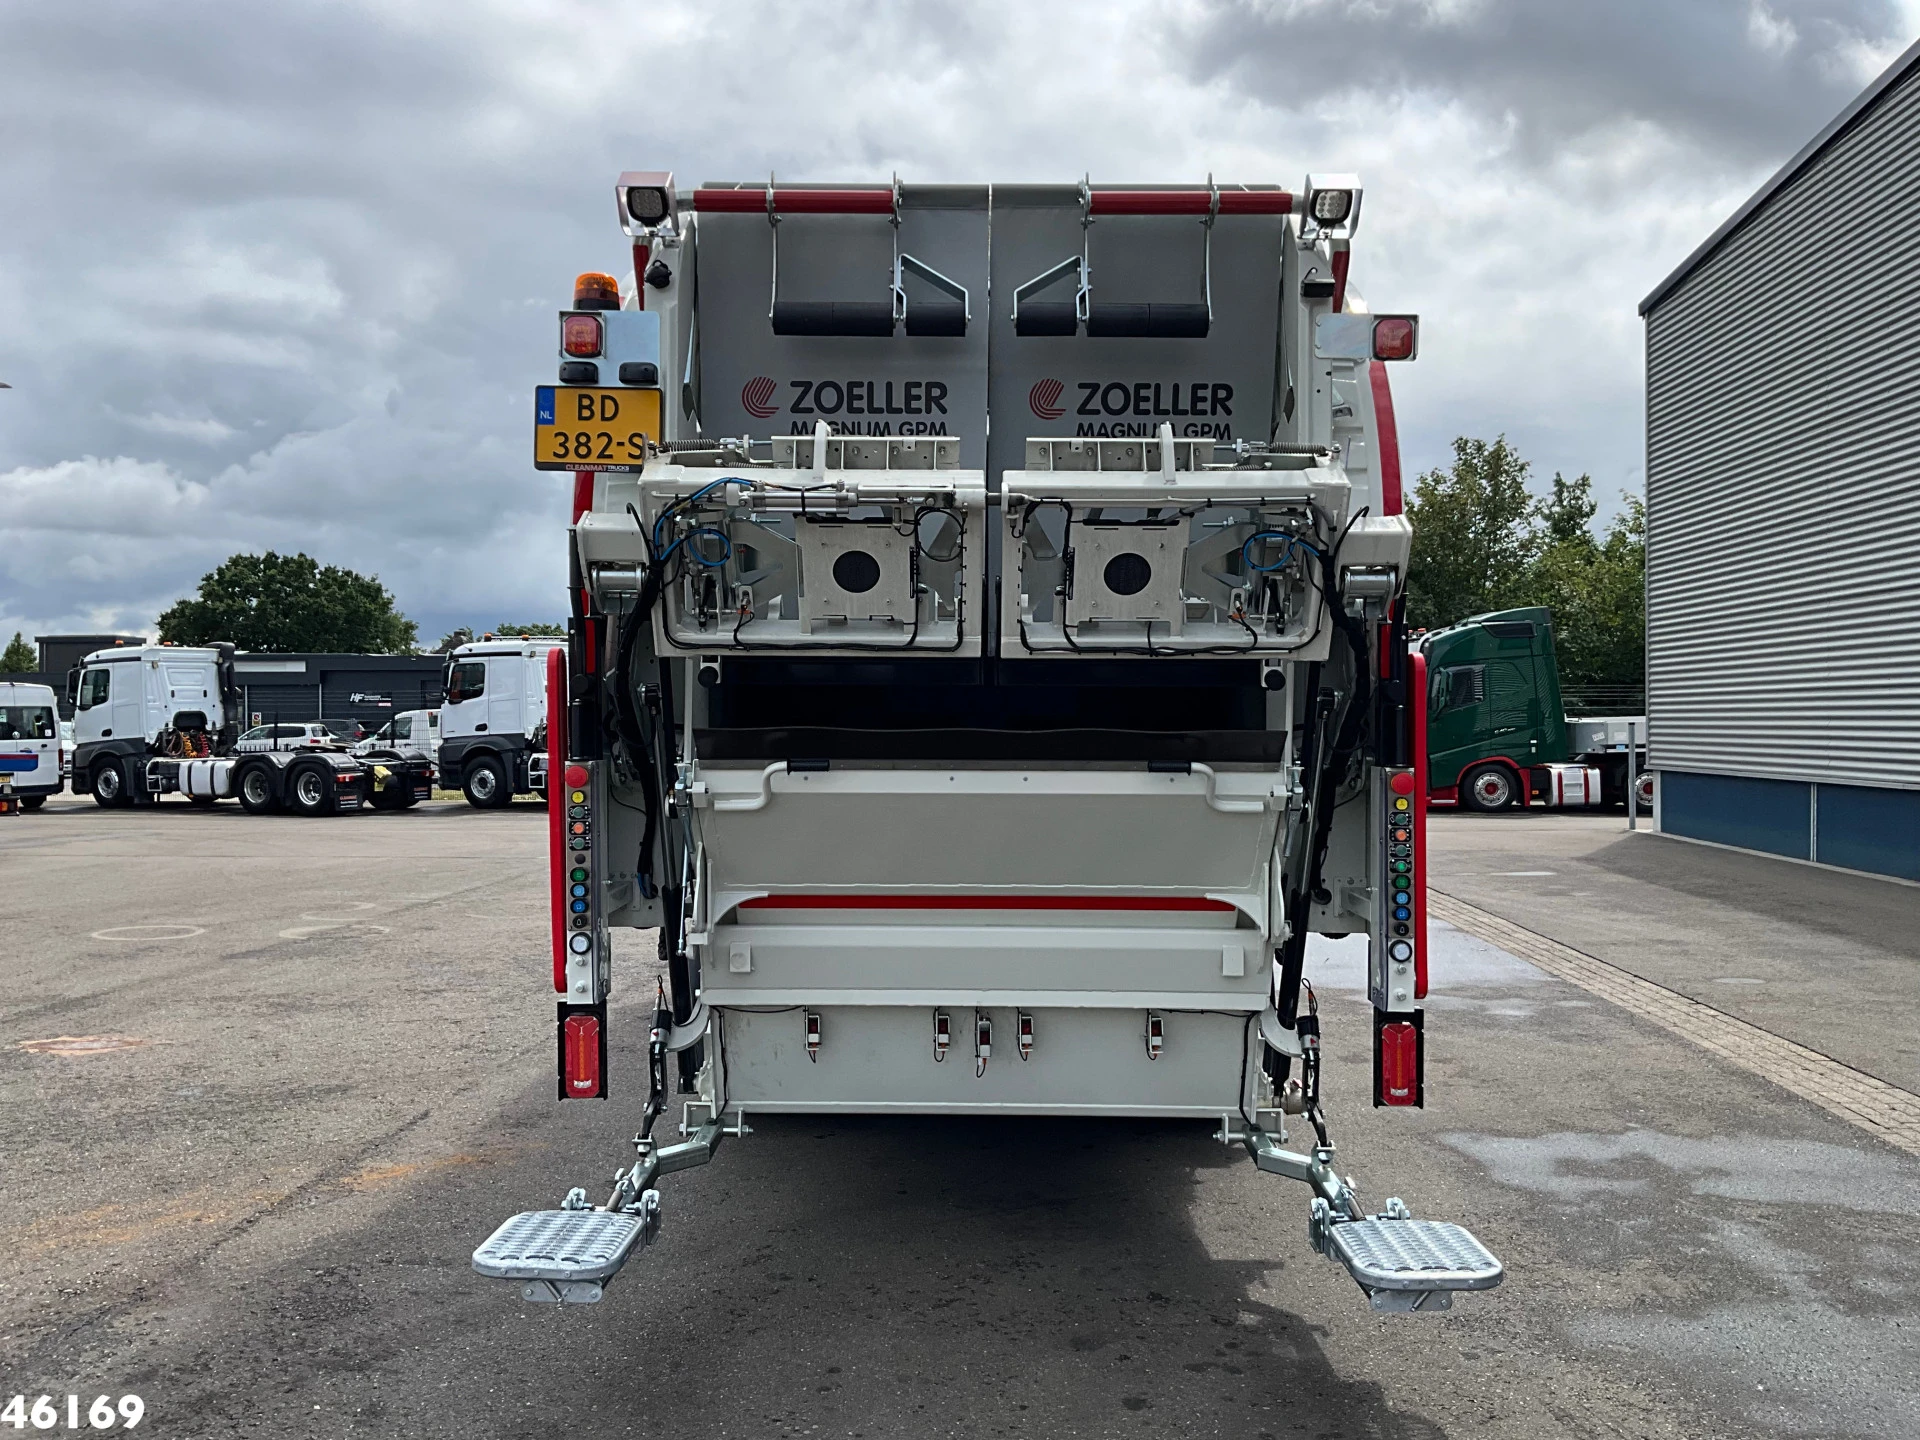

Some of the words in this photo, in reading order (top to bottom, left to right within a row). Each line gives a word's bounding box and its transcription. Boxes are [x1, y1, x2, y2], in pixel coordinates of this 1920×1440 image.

[577, 393, 620, 422] BD
[790, 380, 948, 415] ZOELLER
[1076, 382, 1234, 416] ZOELLER
[540, 410, 553, 420] NL
[898, 421, 948, 437] GPM
[1183, 422, 1232, 440] GPM
